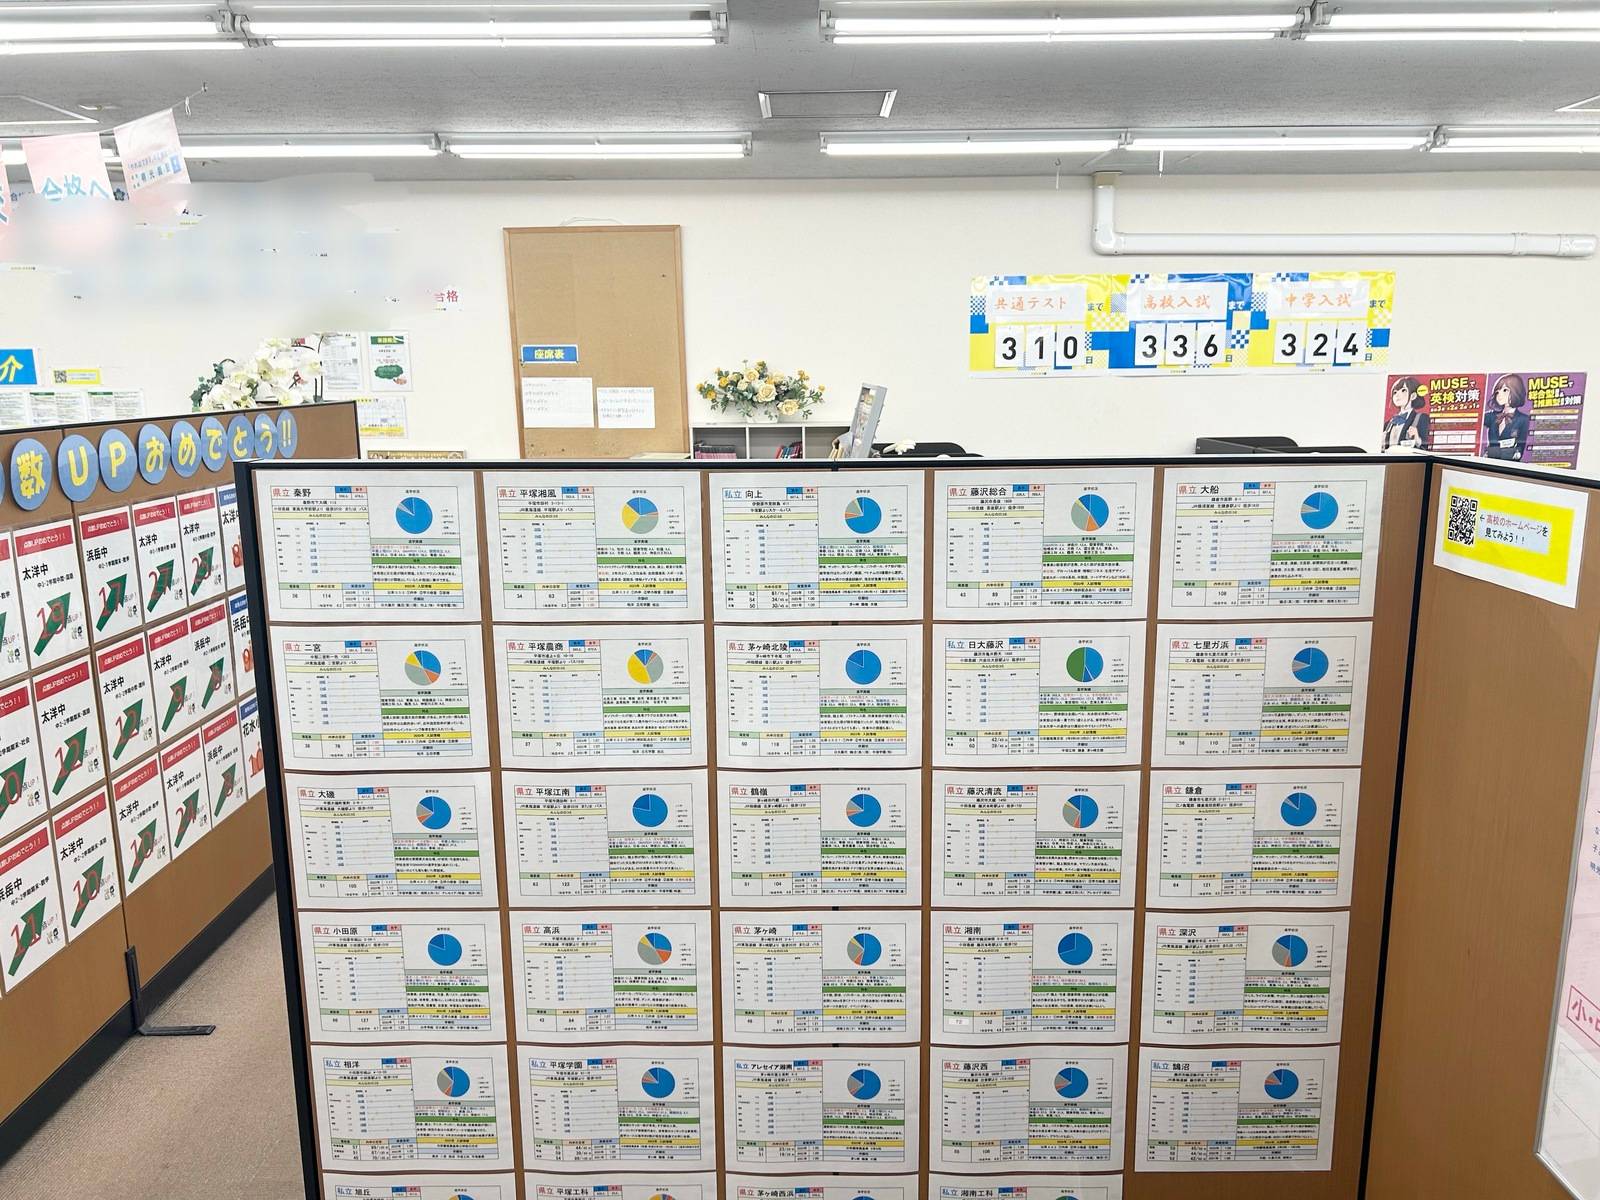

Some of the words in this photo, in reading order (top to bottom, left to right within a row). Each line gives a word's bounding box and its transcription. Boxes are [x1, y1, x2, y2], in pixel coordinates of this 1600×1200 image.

[994, 296, 1067, 310] 共通テスト
[1087, 302, 1104, 312] まで
[1143, 294, 1211, 309] 高校入試
[1228, 300, 1244, 310] まで
[1284, 293, 1352, 308] 中学入試
[1369, 299, 1386, 309] まで
[1001, 335, 1078, 361] 310
[1085, 356, 1093, 365] 日
[1141, 334, 1218, 359] 336
[1225, 353, 1232, 363] 日
[1281, 333, 1359, 357] 324
[1364, 352, 1372, 361] 日
[534, 348, 565, 360] 座席表
[1430, 389, 1480, 405] 英検対策
[272, 488, 290, 497] 県立
[293, 488, 311, 497] 秦野
[498, 489, 516, 498] 県立
[949, 487, 967, 496] 県立
[970, 487, 1007, 496] 藤沢総合
[1178, 485, 1196, 494] 県立
[1200, 485, 1219, 494] 大船
[724, 490, 741, 499] 私立
[745, 490, 762, 499] 向上
[182, 521, 200, 536] 太洋中
[1486, 514, 1548, 538] 高校のホームページを
[138, 532, 158, 548] 太洋中
[86, 545, 109, 563] 浜岳中
[22, 563, 49, 582] 太洋中
[194, 636, 211, 652] 浜岳中
[284, 643, 300, 652] 県立
[508, 642, 524, 651] 県立
[728, 642, 745, 652] 県立
[948, 640, 965, 649] 私立
[968, 640, 1004, 649] 日大藤沢
[1171, 640, 1189, 649] 県立
[153, 653, 172, 671] 太洋中
[103, 675, 125, 695] 太洋中
[41, 703, 66, 725] 太洋中
[207, 744, 223, 762] 浜岳中
[166, 770, 185, 790] 太洋中
[299, 790, 315, 799] 県立
[318, 790, 335, 799] 大磯
[516, 788, 533, 797] 県立
[535, 788, 570, 797] 平塚江南
[731, 787, 747, 796] 県立
[946, 786, 964, 796] 県立
[966, 786, 1002, 796] 藤沢清流
[1164, 786, 1181, 795] 県立
[1185, 786, 1202, 795] 鎌倉
[119, 800, 140, 821] 太洋中
[60, 837, 84, 861] 太洋中
[314, 927, 330, 936] 県立
[333, 927, 358, 936] 小田原
[523, 926, 540, 935] 県立
[543, 926, 560, 935] 高浜
[734, 926, 751, 936] 県立
[944, 926, 962, 935] 県立
[964, 926, 982, 935] 湘南
[1159, 928, 1176, 937] 県立
[1179, 928, 1197, 937] 深沢
[326, 1060, 341, 1068] 私立
[343, 1060, 360, 1068] 相洋
[531, 1060, 547, 1069] 私立
[550, 1060, 583, 1069] 平塚学園
[736, 1063, 749, 1072] 私立
[944, 1062, 960, 1071] 県立
[963, 1062, 988, 1071] 藤沢西
[1153, 1062, 1169, 1071] 私立
[337, 1188, 353, 1196] 私立
[538, 1188, 554, 1196] 県立
[556, 1188, 589, 1196] 平塚工科
[739, 1188, 755, 1197] 県立
[942, 1188, 958, 1197] 私立
